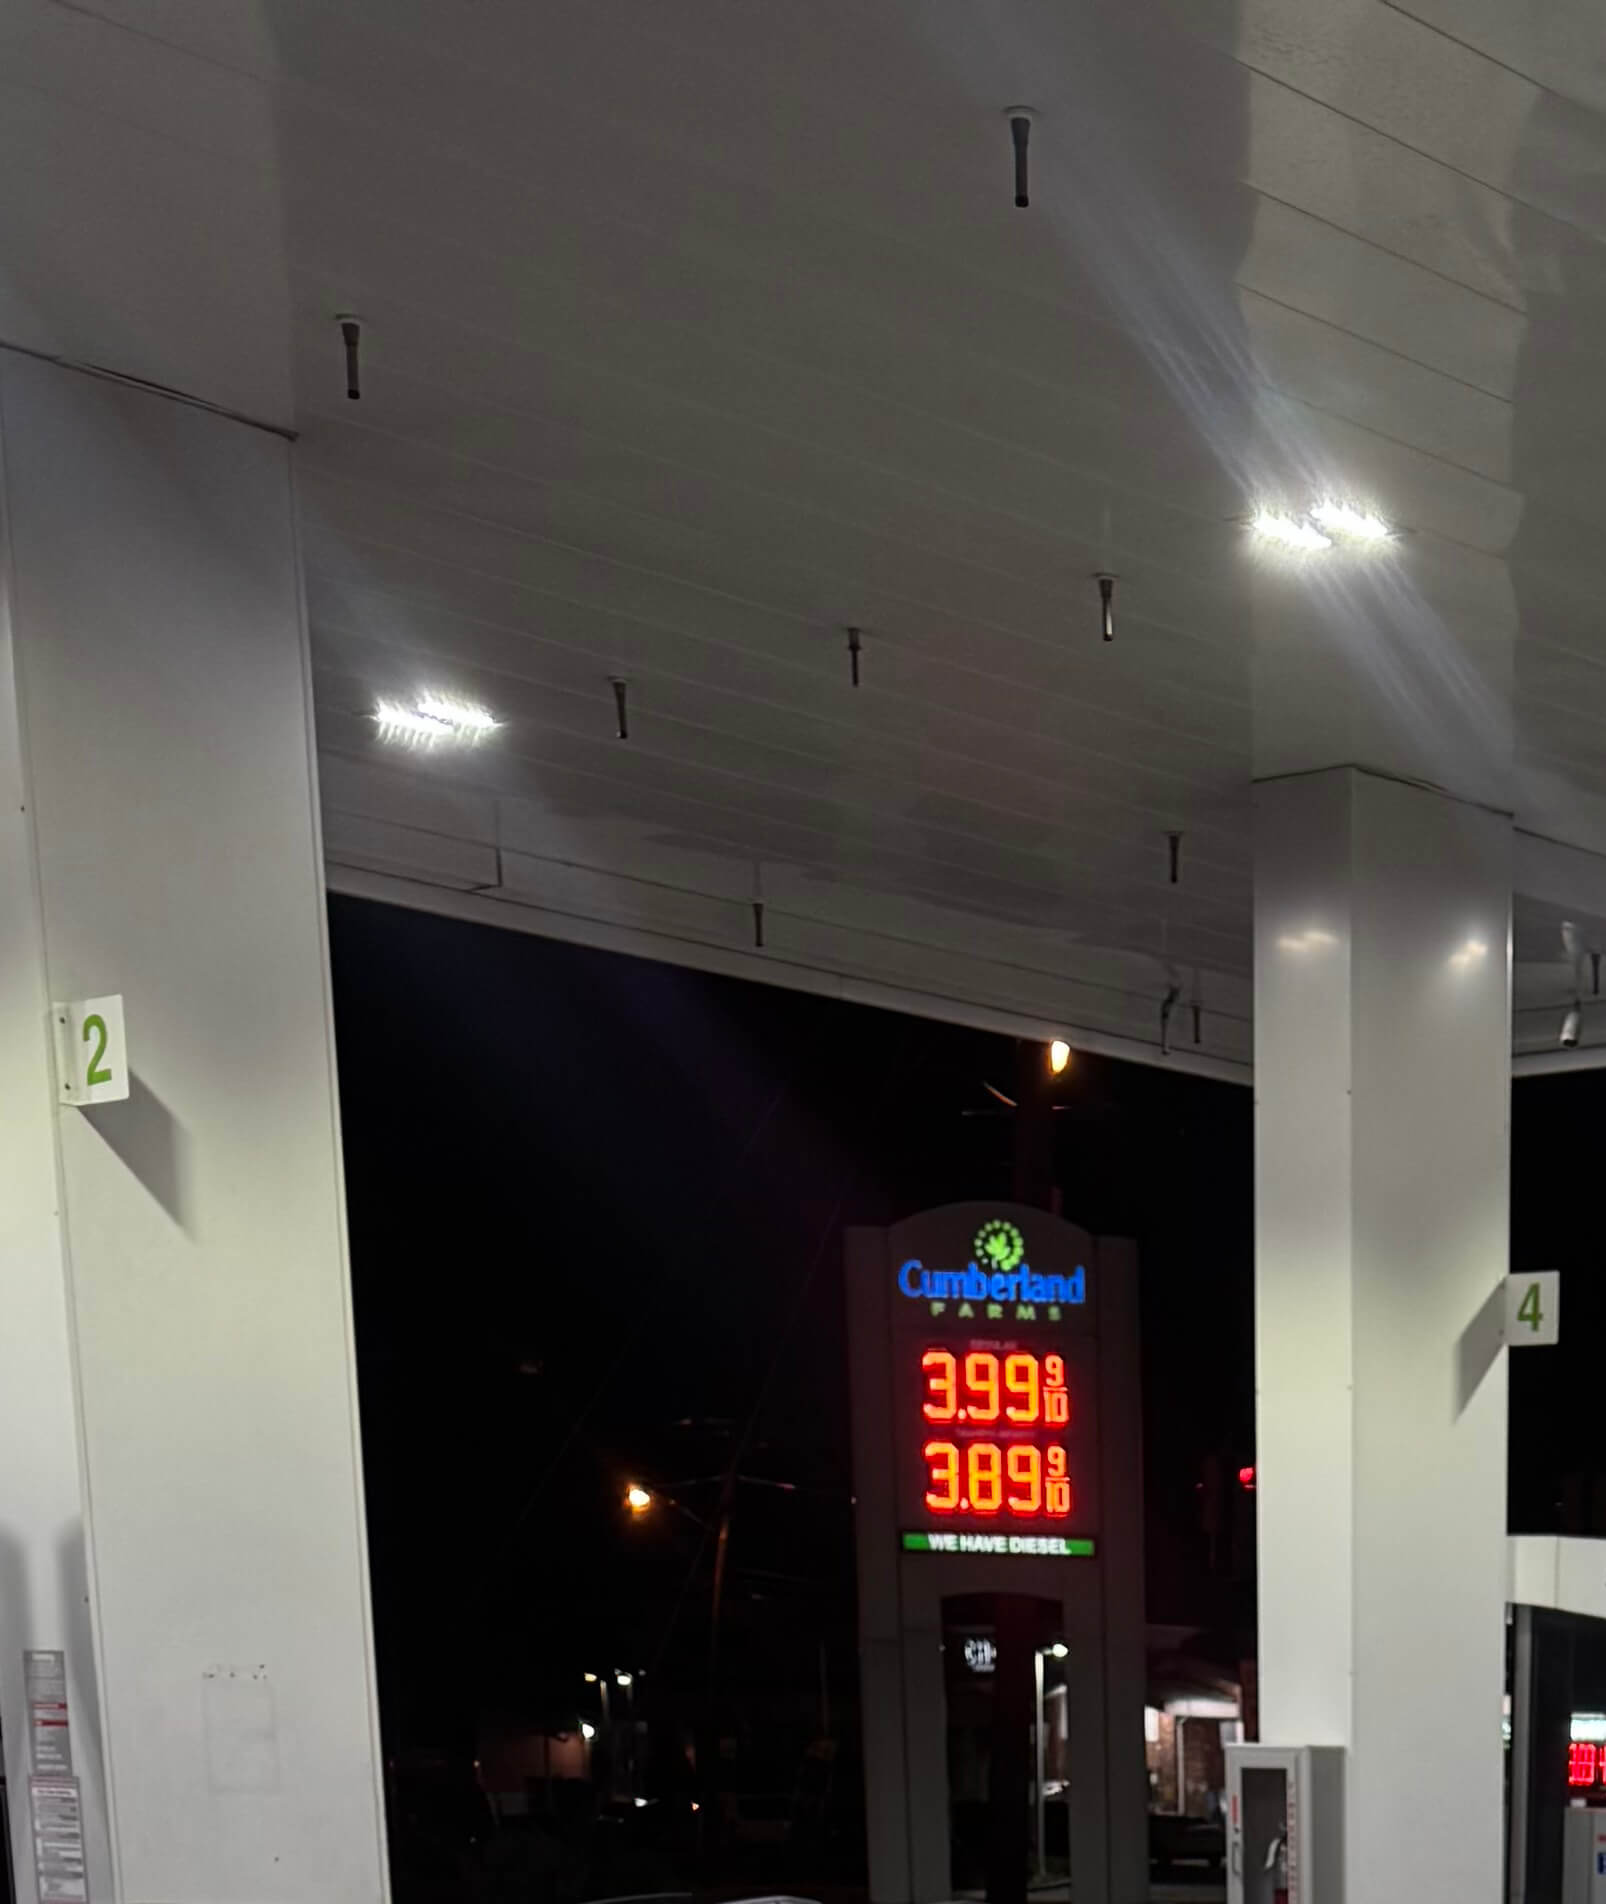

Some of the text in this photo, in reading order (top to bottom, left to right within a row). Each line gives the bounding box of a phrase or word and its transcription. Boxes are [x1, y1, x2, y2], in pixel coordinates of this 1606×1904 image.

[83, 1013, 112, 1087] 2
[898, 1258, 1086, 1304] Cumberland
[929, 1301, 1062, 1321] FARMS
[1517, 1282, 1544, 1333] 4
[922, 1351, 1040, 1422] 3.99
[925, 1441, 1042, 1512] 3.89
[928, 1533, 1072, 1555] WE HAVE DIESEL
